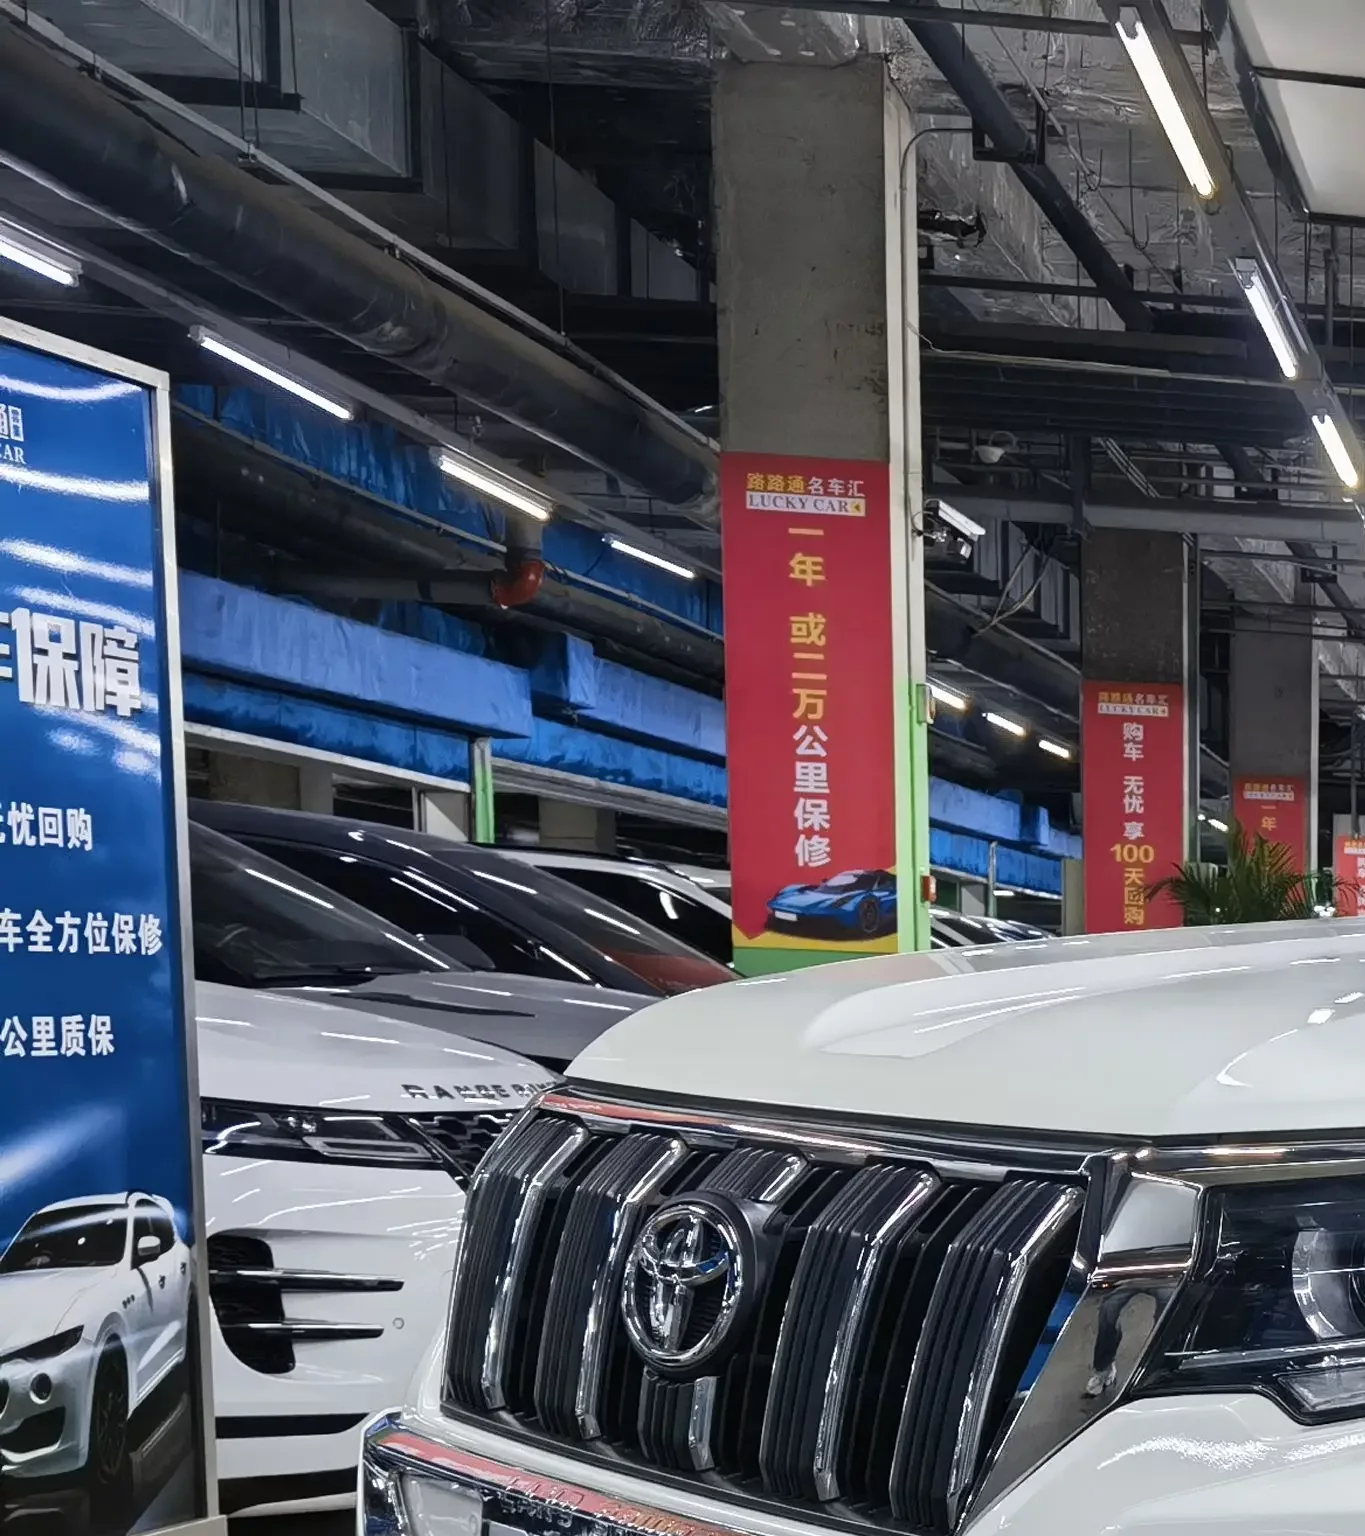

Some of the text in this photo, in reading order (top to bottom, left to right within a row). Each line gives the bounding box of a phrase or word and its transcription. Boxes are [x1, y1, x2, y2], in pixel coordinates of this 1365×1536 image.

[746, 473, 866, 497] 路路通名车汇
[749, 494, 849, 513] LUCKY CAR
[788, 528, 831, 867] 一年 或二万公里保修
[1123, 722, 1144, 761] 购车
[1110, 843, 1154, 863] 100
[0, 907, 163, 956] 车全方位保修
[0, 1013, 115, 1058] 公里质保
